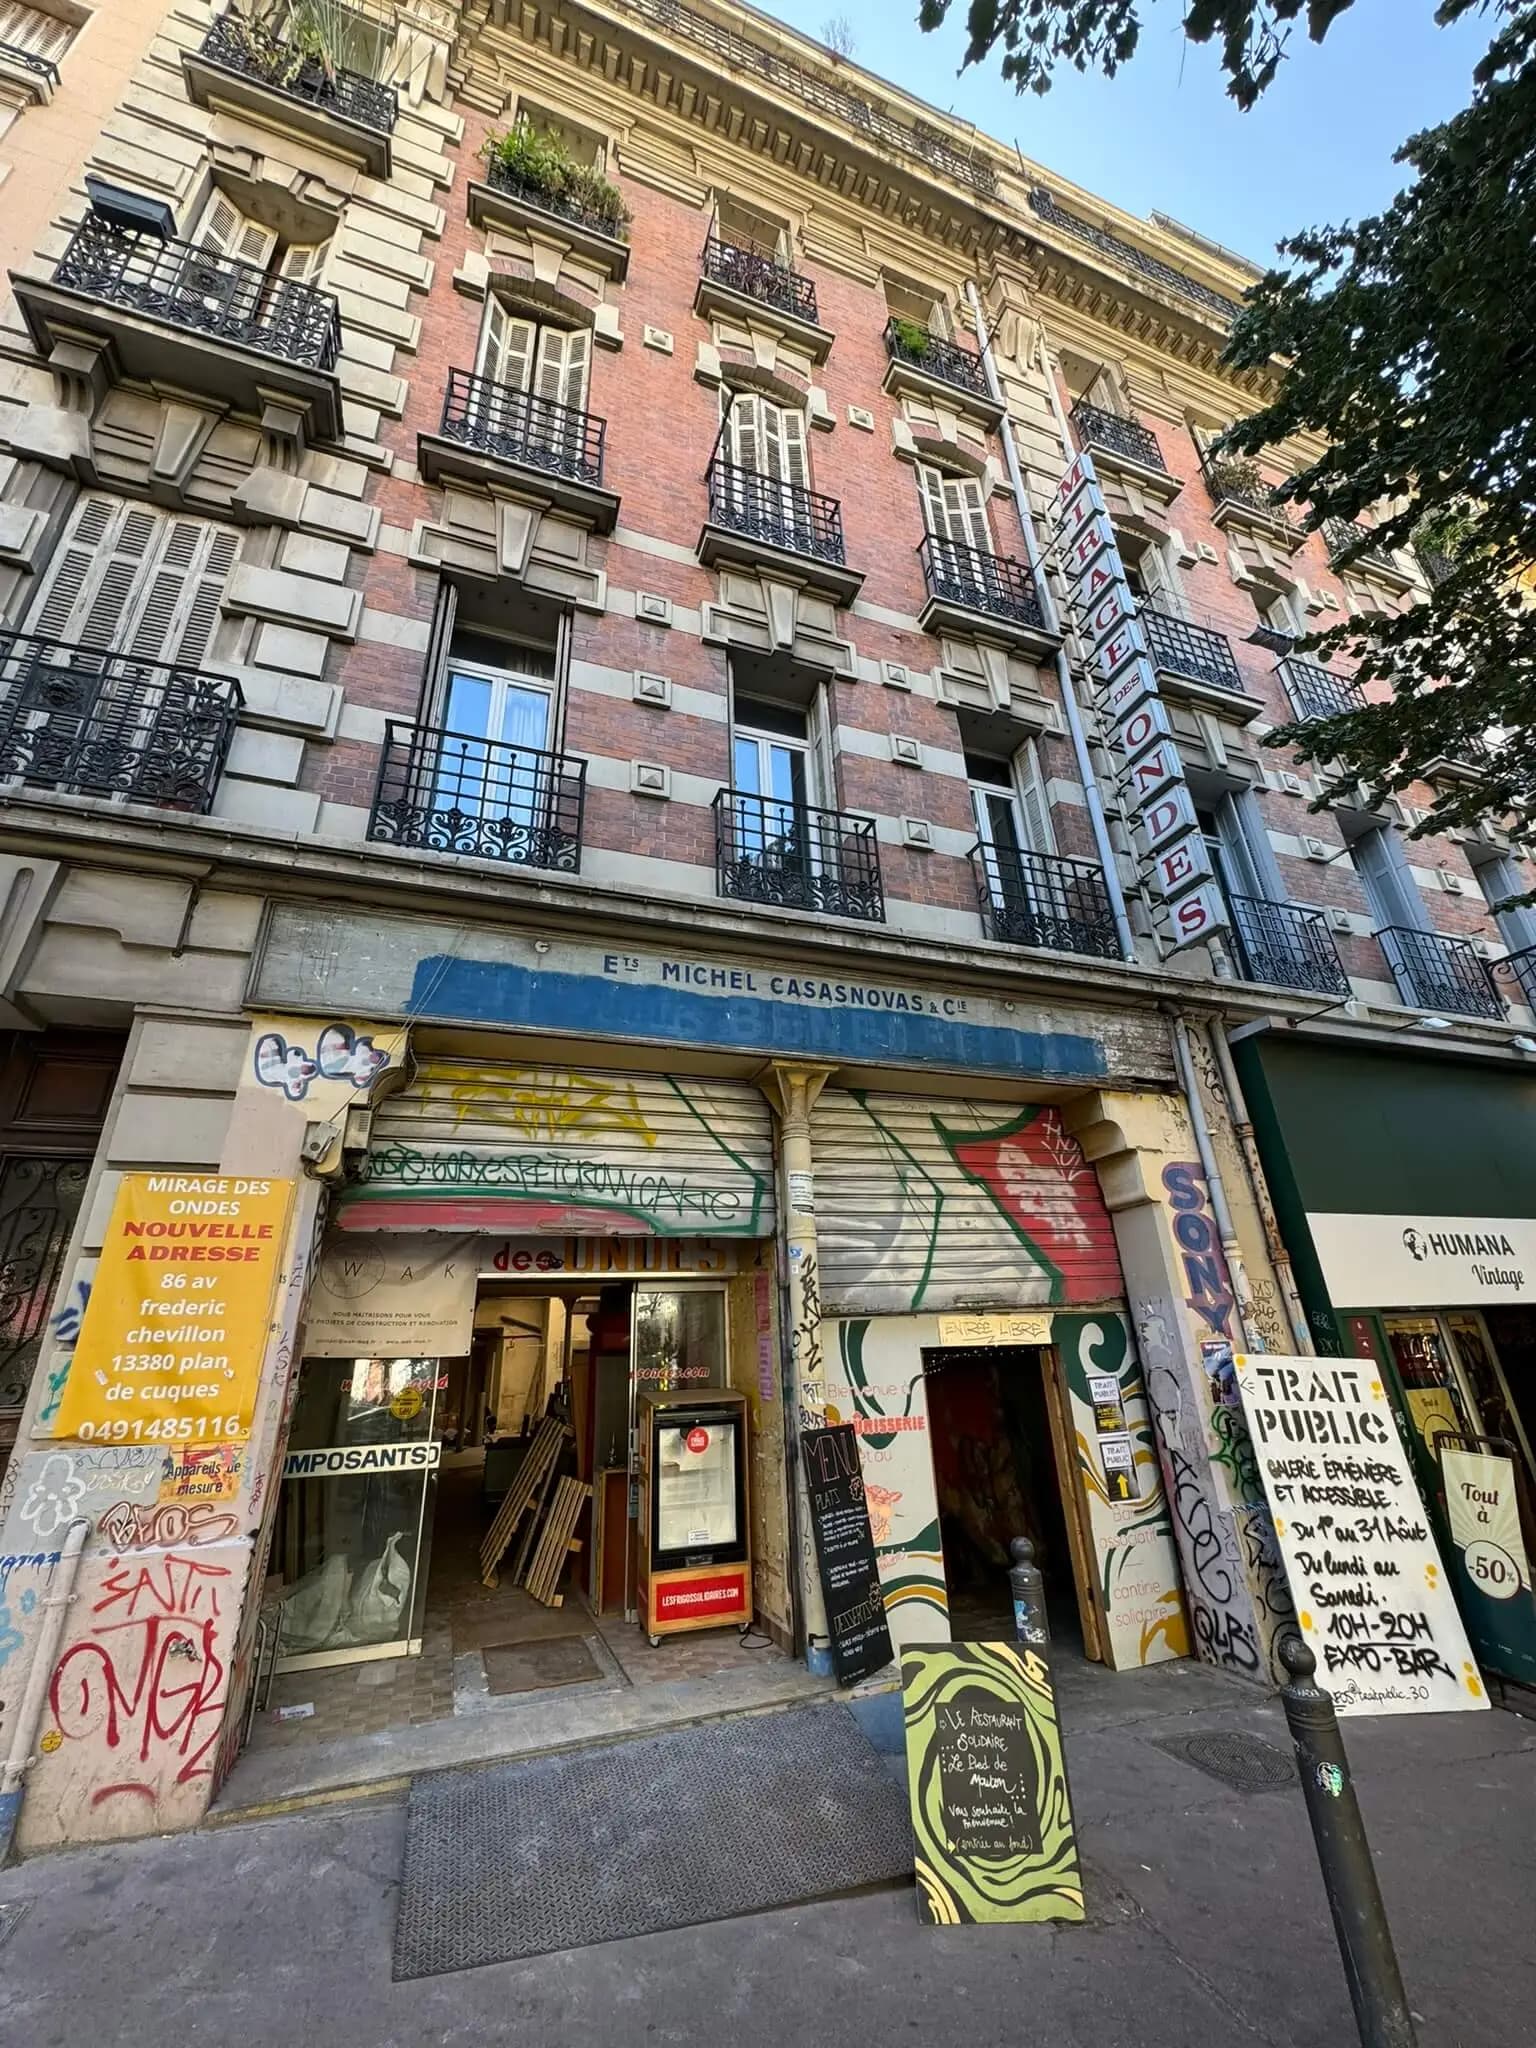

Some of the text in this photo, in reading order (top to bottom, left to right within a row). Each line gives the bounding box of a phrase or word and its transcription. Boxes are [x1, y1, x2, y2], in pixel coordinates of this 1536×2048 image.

[1057, 462, 1131, 671] MIRAGE
[1112, 671, 1141, 707] DES
[1126, 713, 1207, 936] ONDES
[661, 961, 757, 992] MICHEL
[770, 976, 923, 1012] CASASNOVAS
[929, 1001, 939, 1014] &
[147, 1177, 271, 1196] MIRAGE DES
[169, 1200, 241, 1217] ONDES
[122, 1221, 273, 1240] NOUVELLE
[126, 1245, 260, 1262] ADRESSE
[1162, 1161, 1234, 1341] SONY
[1427, 1232, 1515, 1257] HUMANA
[161, 1273, 216, 1289] 86 av
[1471, 1263, 1525, 1291] Vintage
[140, 1299, 225, 1316] frederic
[126, 1325, 225, 1344] chevillon
[111, 1352, 228, 1376] 13380 plan
[105, 1382, 220, 1406] de cuques
[827, 1383, 897, 1399] Bienvenue
[1255, 1368, 1362, 1403] TRAIT
[78, 1415, 239, 1441] 0491485116
[1253, 1408, 1390, 1444] PUBLIC
[166, 1457, 222, 1479] Appareils
[803, 1431, 860, 1488] MENU
[176, 1481, 224, 1497] mesure
[815, 1488, 841, 1512] PLATS
[1273, 1484, 1295, 1503] ET
[1460, 1482, 1500, 1506] Tout
[1112, 1503, 1135, 1522] Bar
[1477, 1504, 1490, 1524] à
[1099, 1526, 1157, 1549] associatif
[1334, 1528, 1360, 1543] au
[1355, 1516, 1386, 1543] 31
[1294, 1550, 1401, 1577] Du lundi au
[1113, 1579, 1161, 1600] cantine
[1114, 1604, 1168, 1628] solidaire
[945, 1706, 1023, 1731] LE RESTAURANT
[957, 1733, 1009, 1754] SOLIDAIRE
[948, 1753, 1008, 1773] Le Pied de
[1013, 1801, 1028, 1816] la
[993, 1838, 1007, 1850] au
